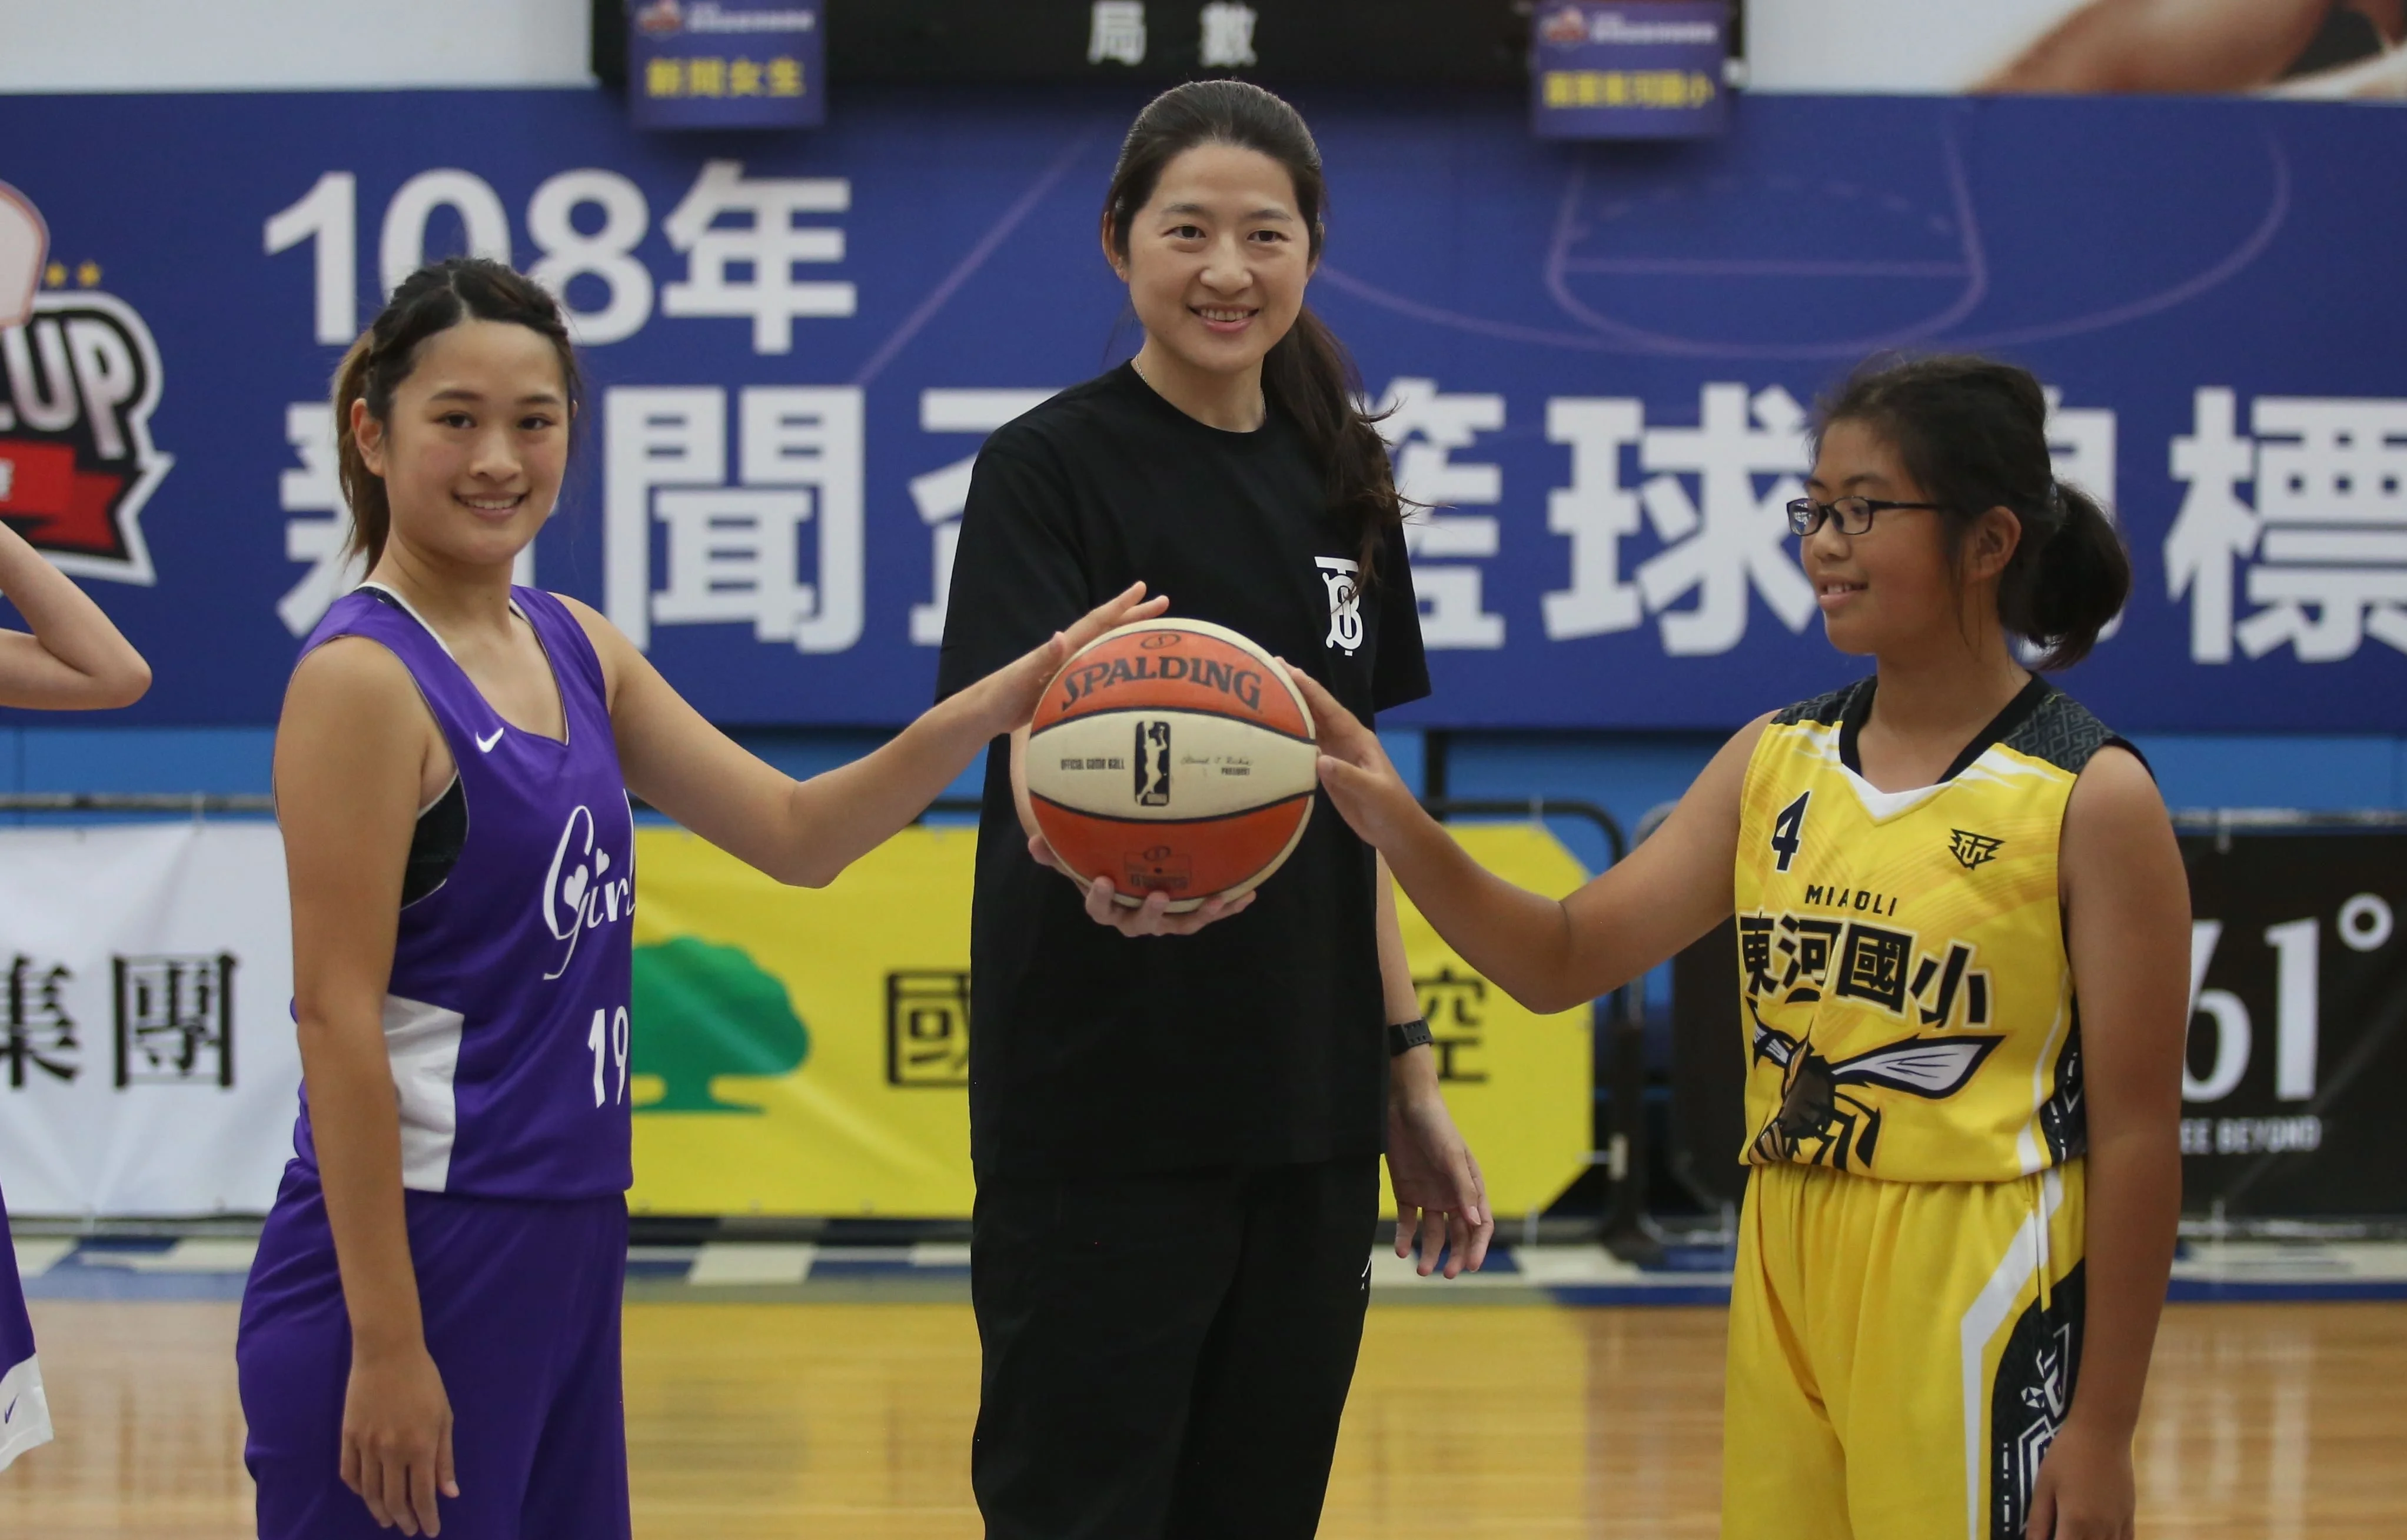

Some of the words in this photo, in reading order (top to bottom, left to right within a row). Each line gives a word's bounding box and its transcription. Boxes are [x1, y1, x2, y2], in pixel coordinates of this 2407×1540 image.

[263, 159, 857, 354] 108年
[0, 318, 137, 460] UP
[1062, 656, 1263, 713] SPALDING
[1771, 790, 1811, 873] 4
[1805, 884, 1897, 917] MIAOLI
[1739, 909, 1992, 1030] 東河國小
[589, 1006, 629, 1109] 19
